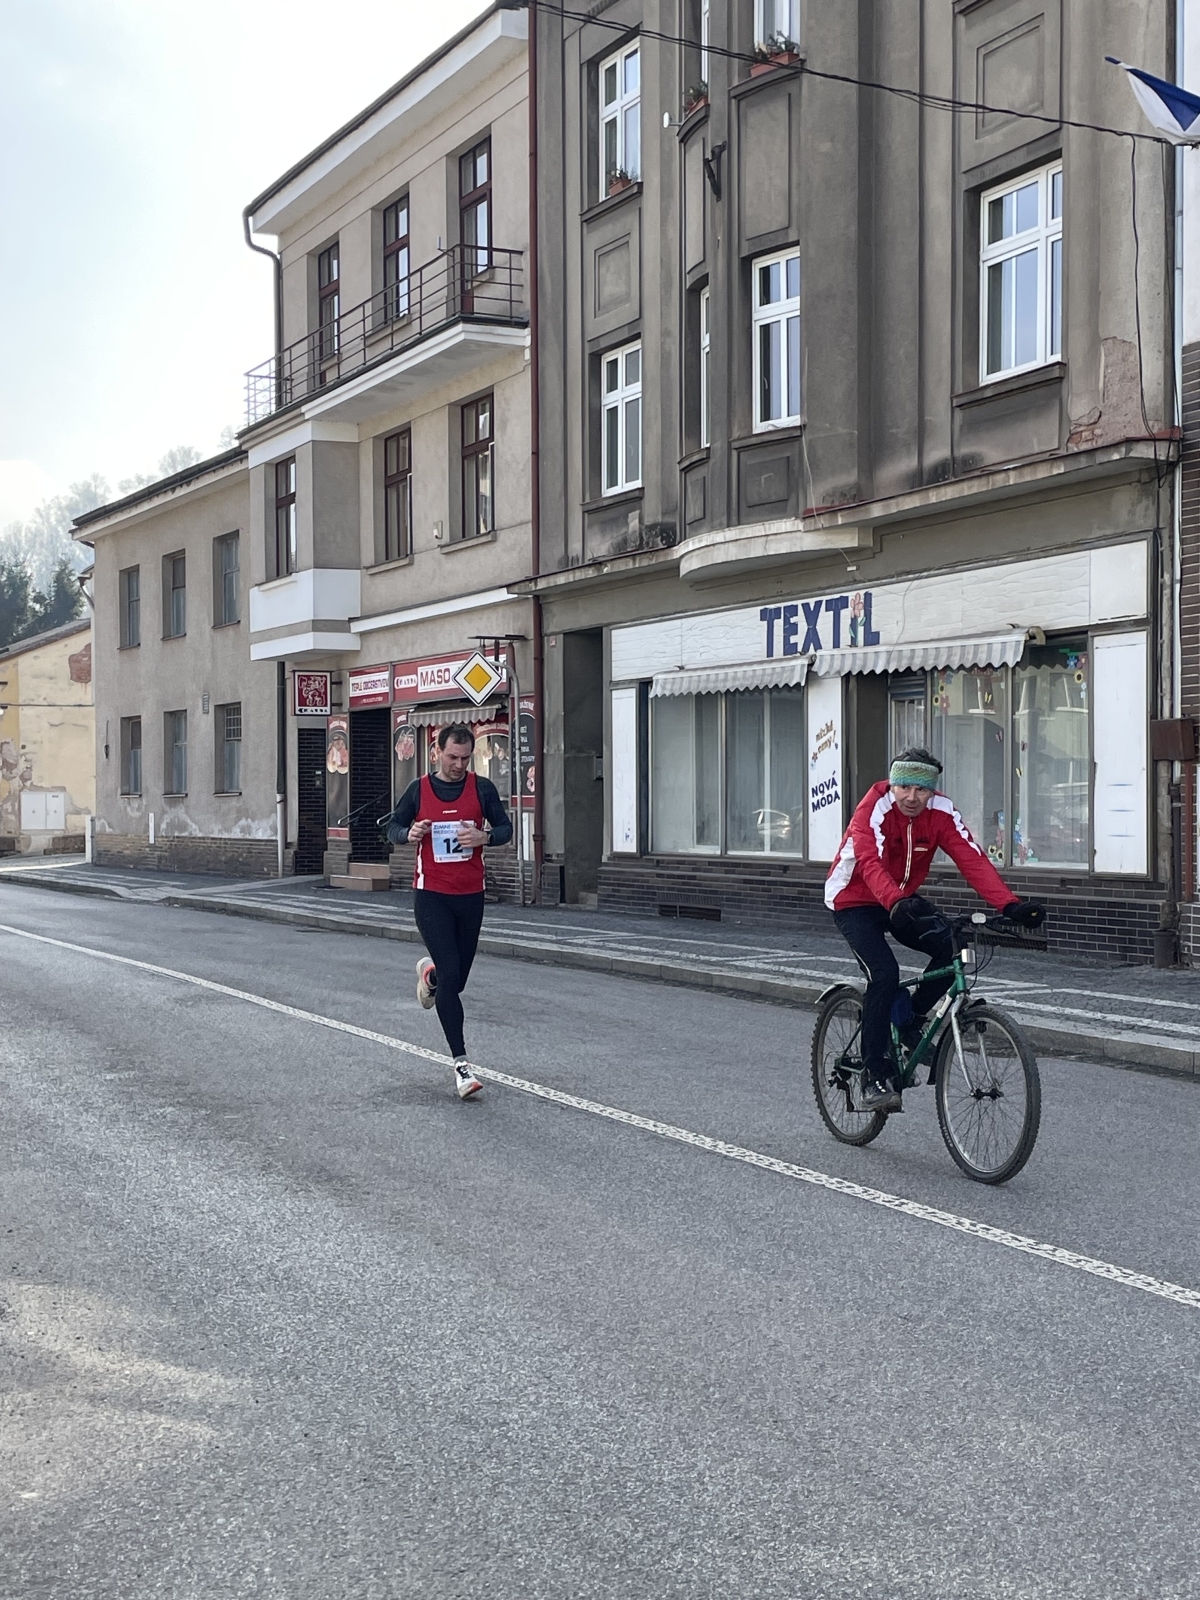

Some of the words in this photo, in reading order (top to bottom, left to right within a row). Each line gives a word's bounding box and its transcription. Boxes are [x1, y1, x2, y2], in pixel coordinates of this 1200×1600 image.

[760, 591, 880, 658] TEXTIL
[420, 667, 451, 688] MASO
[811, 770, 838, 798] NOVÁ
[443, 837, 463, 854] 12
